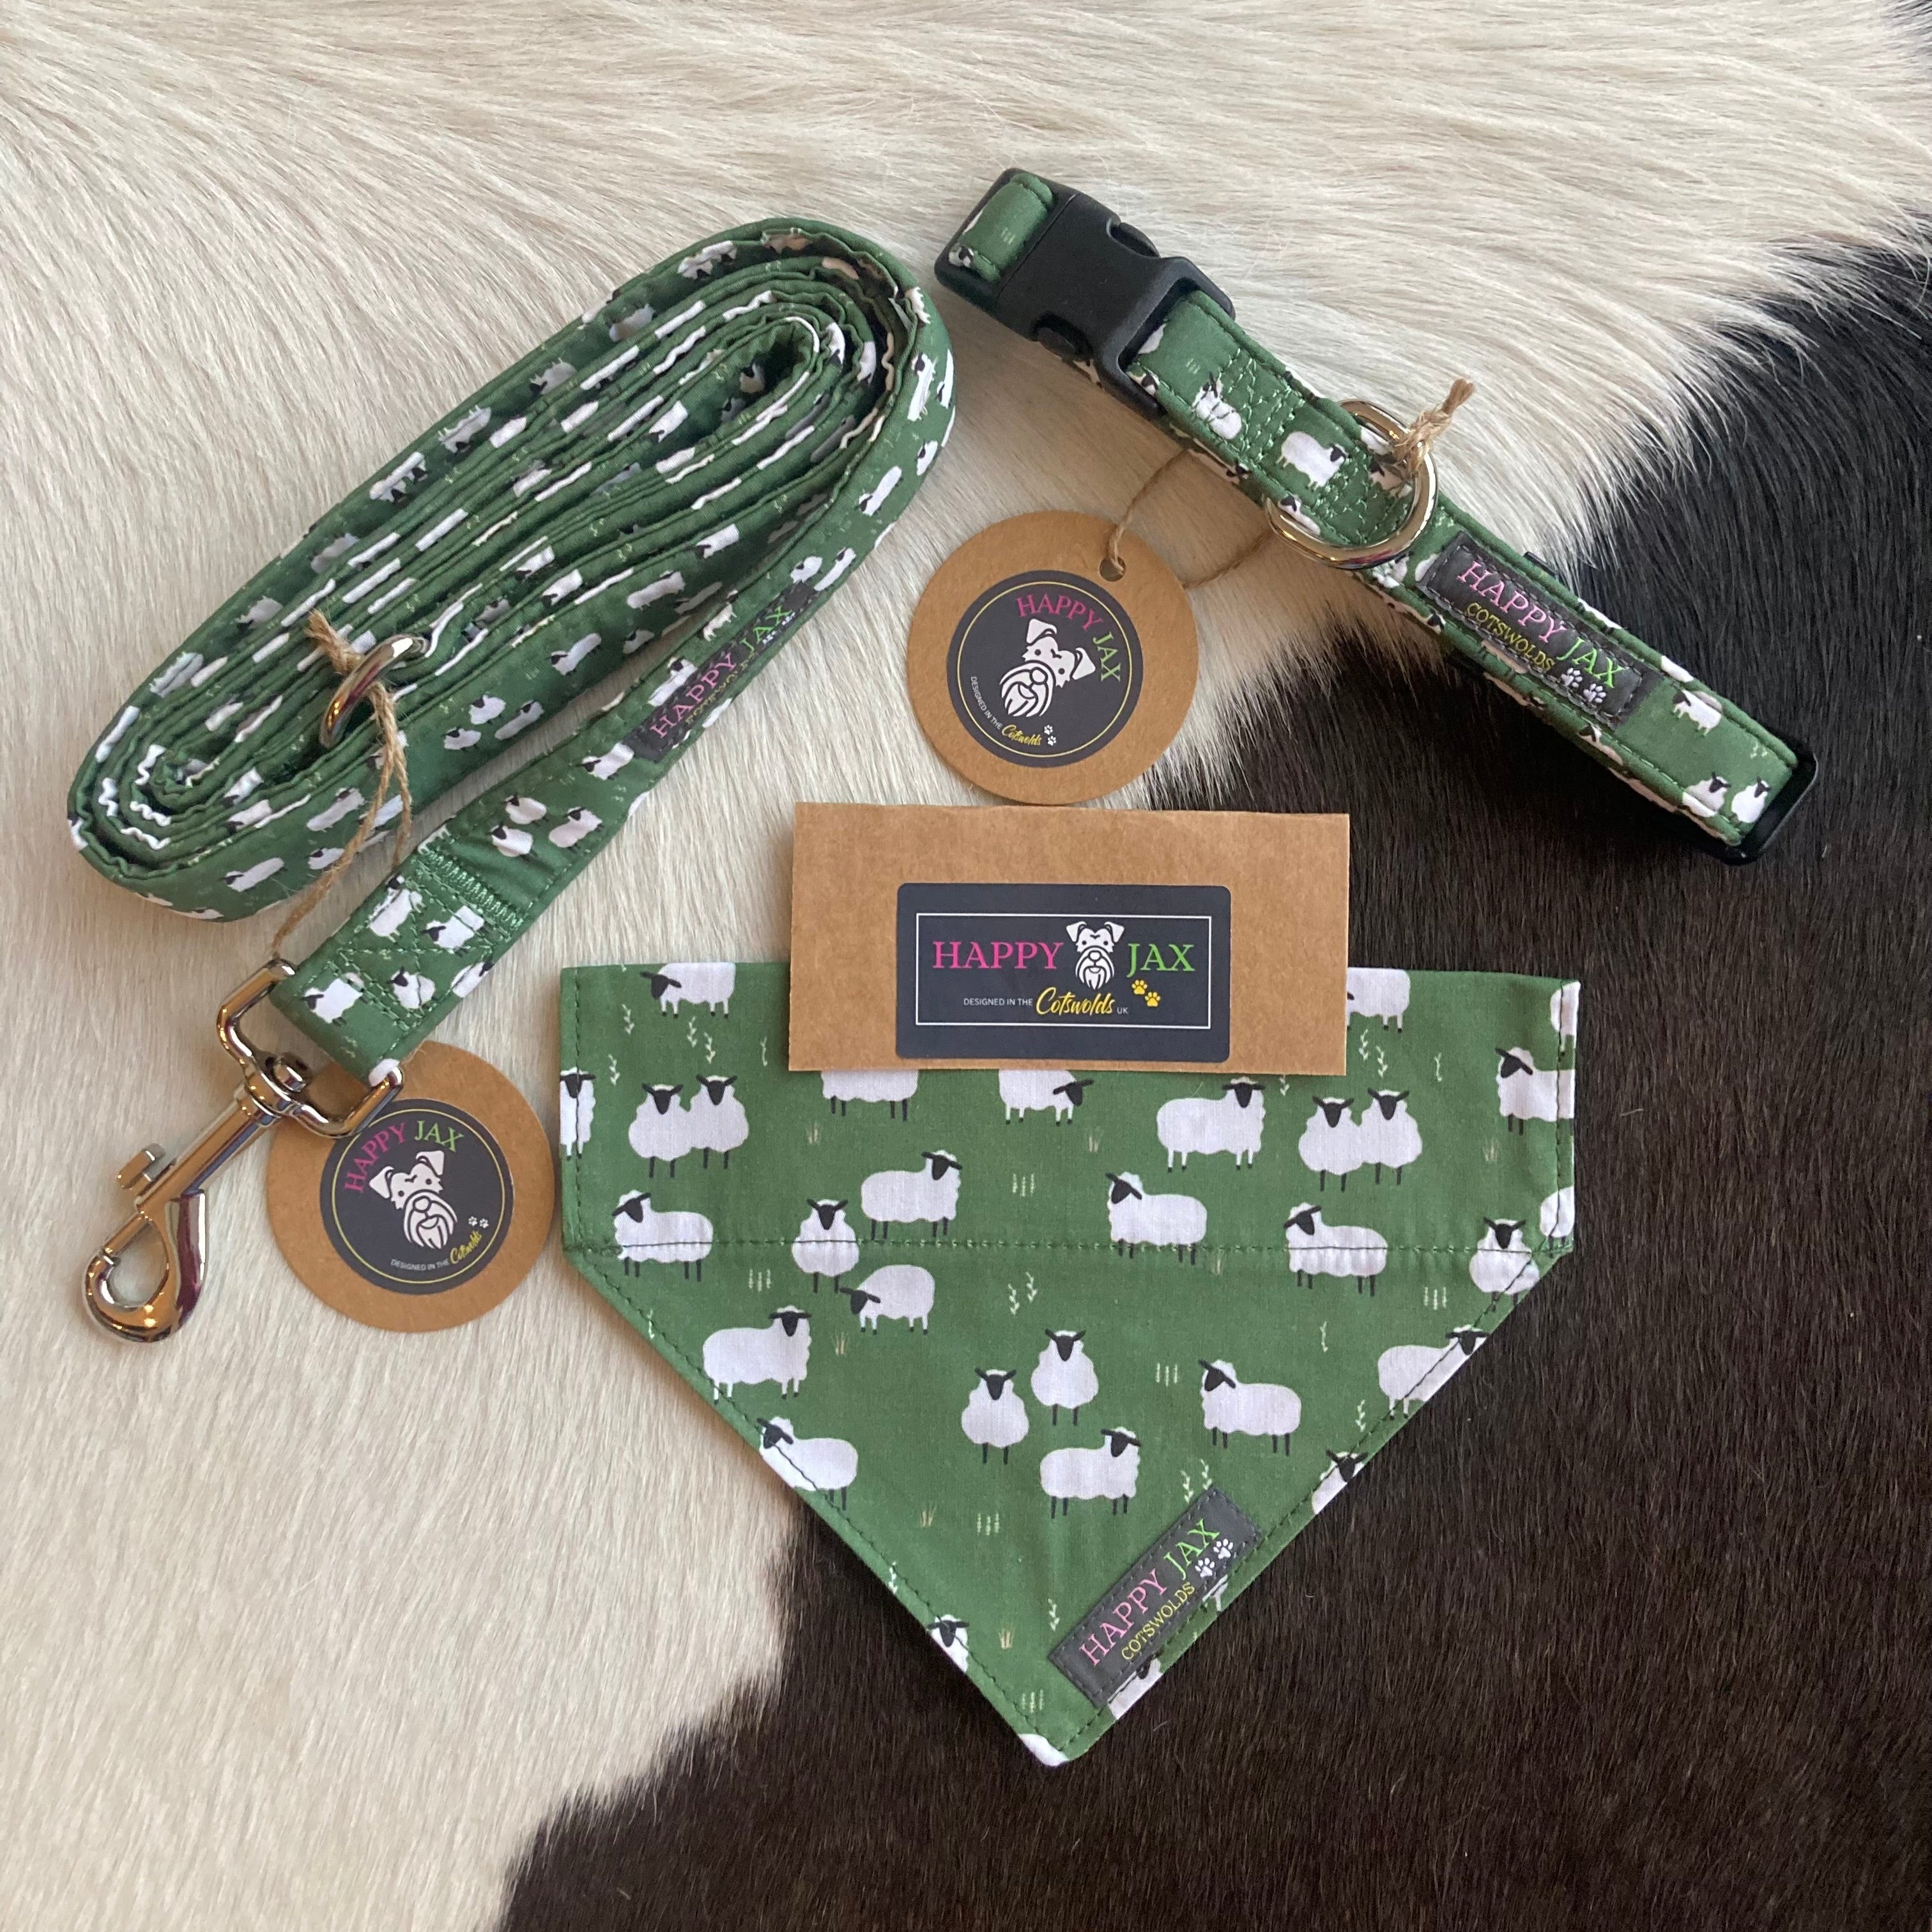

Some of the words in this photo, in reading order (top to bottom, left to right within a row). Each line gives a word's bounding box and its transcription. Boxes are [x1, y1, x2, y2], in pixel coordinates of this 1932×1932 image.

[1016, 593, 1103, 631] HAPPY
[1092, 631, 1121, 682] JAX
[1457, 561, 1566, 643] HAPPY
[1556, 636, 1625, 688] JAX
[1466, 602, 1555, 671] COTSWOLDS
[650, 653, 736, 738] HAPPY
[741, 605, 792, 653] JAX
[970, 676, 987, 711] DESIGNED
[984, 710, 992, 719] IN
[990, 716, 1003, 730] THE
[932, 941, 1063, 970] HAPPY
[1127, 943, 1195, 977] JAX
[1018, 998, 1033, 1006] THE
[1036, 986, 1116, 1015] Cotswolds
[344, 1122, 406, 1193] HAPPY
[413, 1120, 464, 1152] JAX
[390, 1259, 426, 1271] DESIGNED
[436, 1257, 449, 1268] THE
[1079, 1568, 1167, 1666] HAPPY
[1163, 1518, 1220, 1580] JAX
[1121, 1582, 1195, 1660] COTSWOLDS
